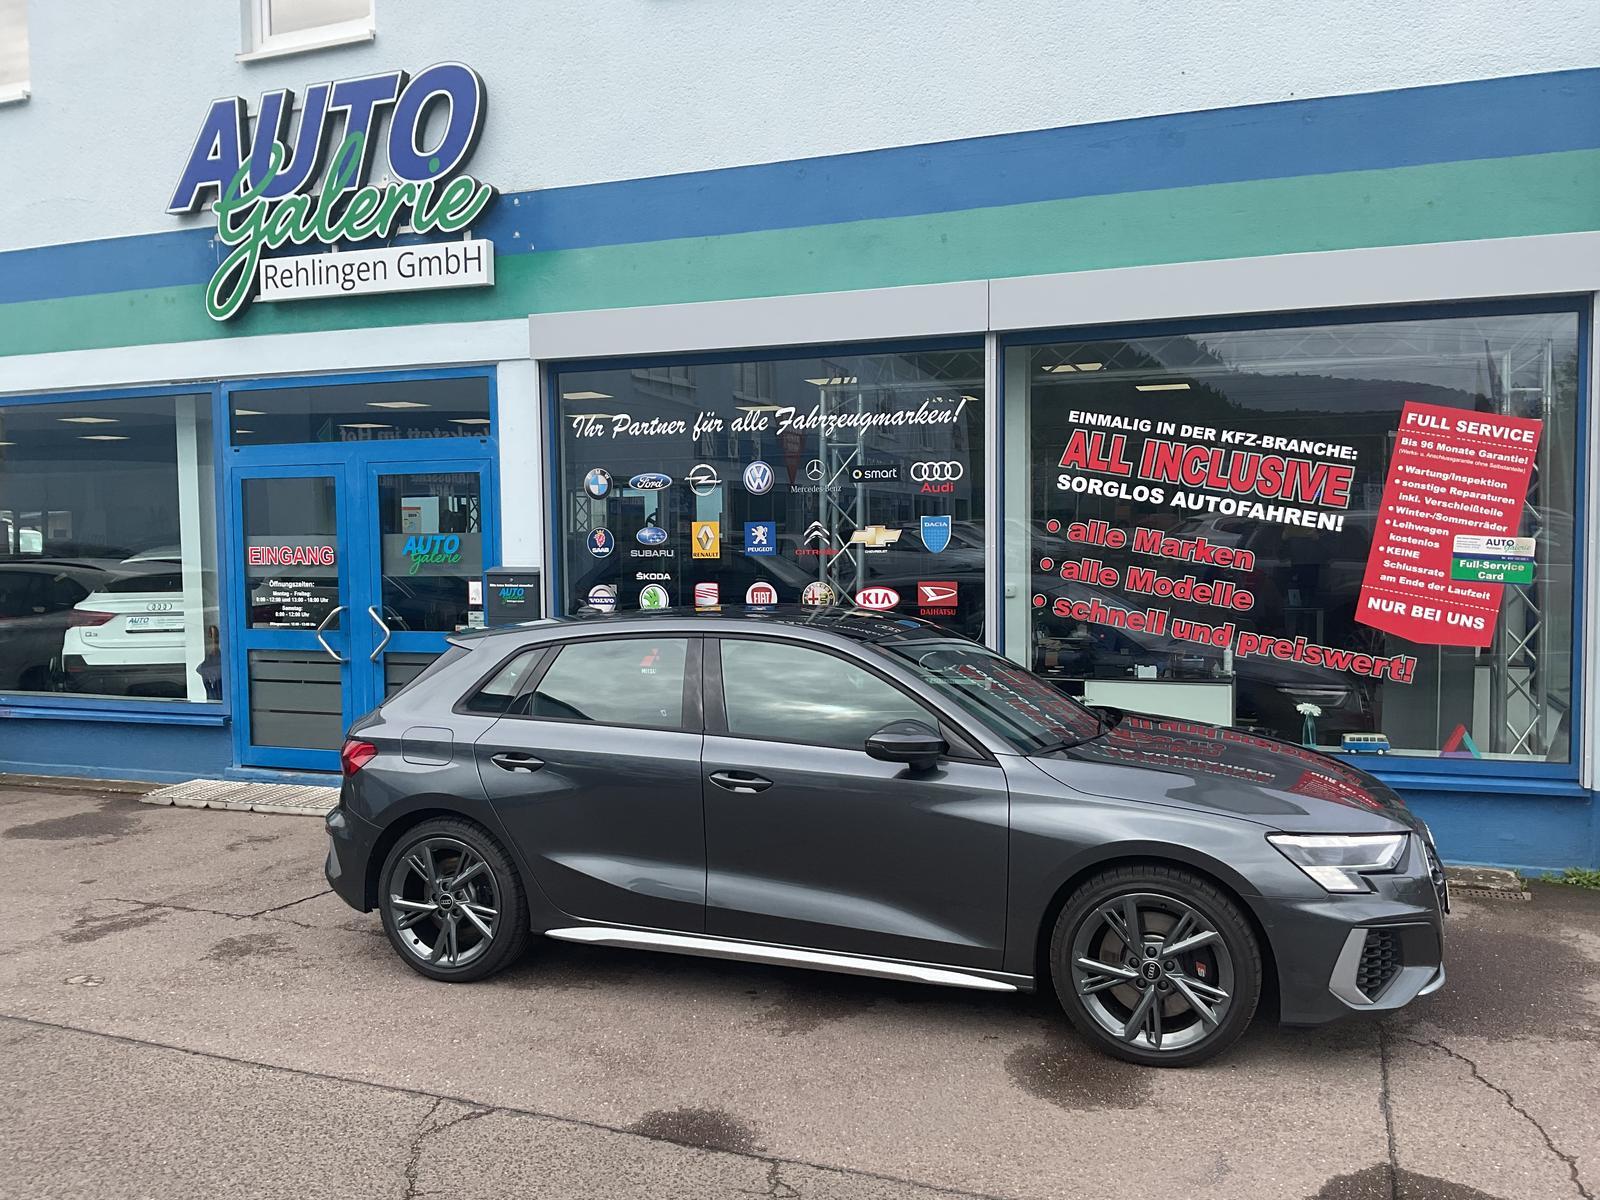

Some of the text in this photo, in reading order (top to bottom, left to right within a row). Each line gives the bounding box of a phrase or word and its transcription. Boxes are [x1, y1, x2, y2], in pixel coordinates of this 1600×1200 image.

[165, 61, 482, 214] AUTO
[205, 131, 492, 321] Galerie
[264, 245, 482, 291] Rehlingen GmbH
[572, 398, 967, 442] Ihr Partner für alle Fahrzeugmarken!
[1406, 412, 1535, 443] FULL SERVICE
[1068, 410, 1358, 461] EINMALIG IN DER KFZ-BRANCHE:
[1401, 437, 1528, 465] Bis 96 Monate Garantie!
[864, 468, 898, 479] smart
[1057, 428, 1356, 510] ALL INCLUSIVE
[1405, 465, 1508, 489] Wartung/Inspektion
[636, 476, 664, 489] Ford
[920, 482, 954, 493] Audi
[1401, 480, 1516, 505] sonstige Reparaturen
[1056, 473, 1345, 532] SORGLOS AUTOFAHREN!
[1398, 493, 1504, 518] inkl. Verschleißteile
[1392, 519, 1449, 536] Leihwagen
[1395, 506, 1508, 532] Winter-/Sommerräder
[402, 534, 460, 556] AUTO
[1067, 518, 1256, 572] alle Marken
[1389, 532, 1440, 548] kostenlos
[1486, 538, 1515, 547] AUTO
[248, 545, 335, 566] EINGANG
[409, 543, 462, 575] Galerie
[630, 550, 674, 558] SUBARU
[795, 548, 839, 556] CITR
[1386, 546, 1421, 559] KEINE
[636, 571, 671, 580] ŠKODA
[1383, 559, 1445, 578] Schlussrate
[1459, 560, 1525, 572] Full-Service
[1477, 571, 1504, 580] Card
[269, 580, 315, 589] Öffnungszeiten:
[1060, 557, 1255, 612] alle Modelle
[1380, 574, 1491, 600] am Ende der Laufzeit
[753, 591, 770, 604] FIAT
[862, 592, 893, 604] KIA
[920, 608, 957, 616] DAIHATSU
[1367, 596, 1485, 630] NUR BEI UNS
[1052, 597, 1418, 684] schnell und preiswert!
